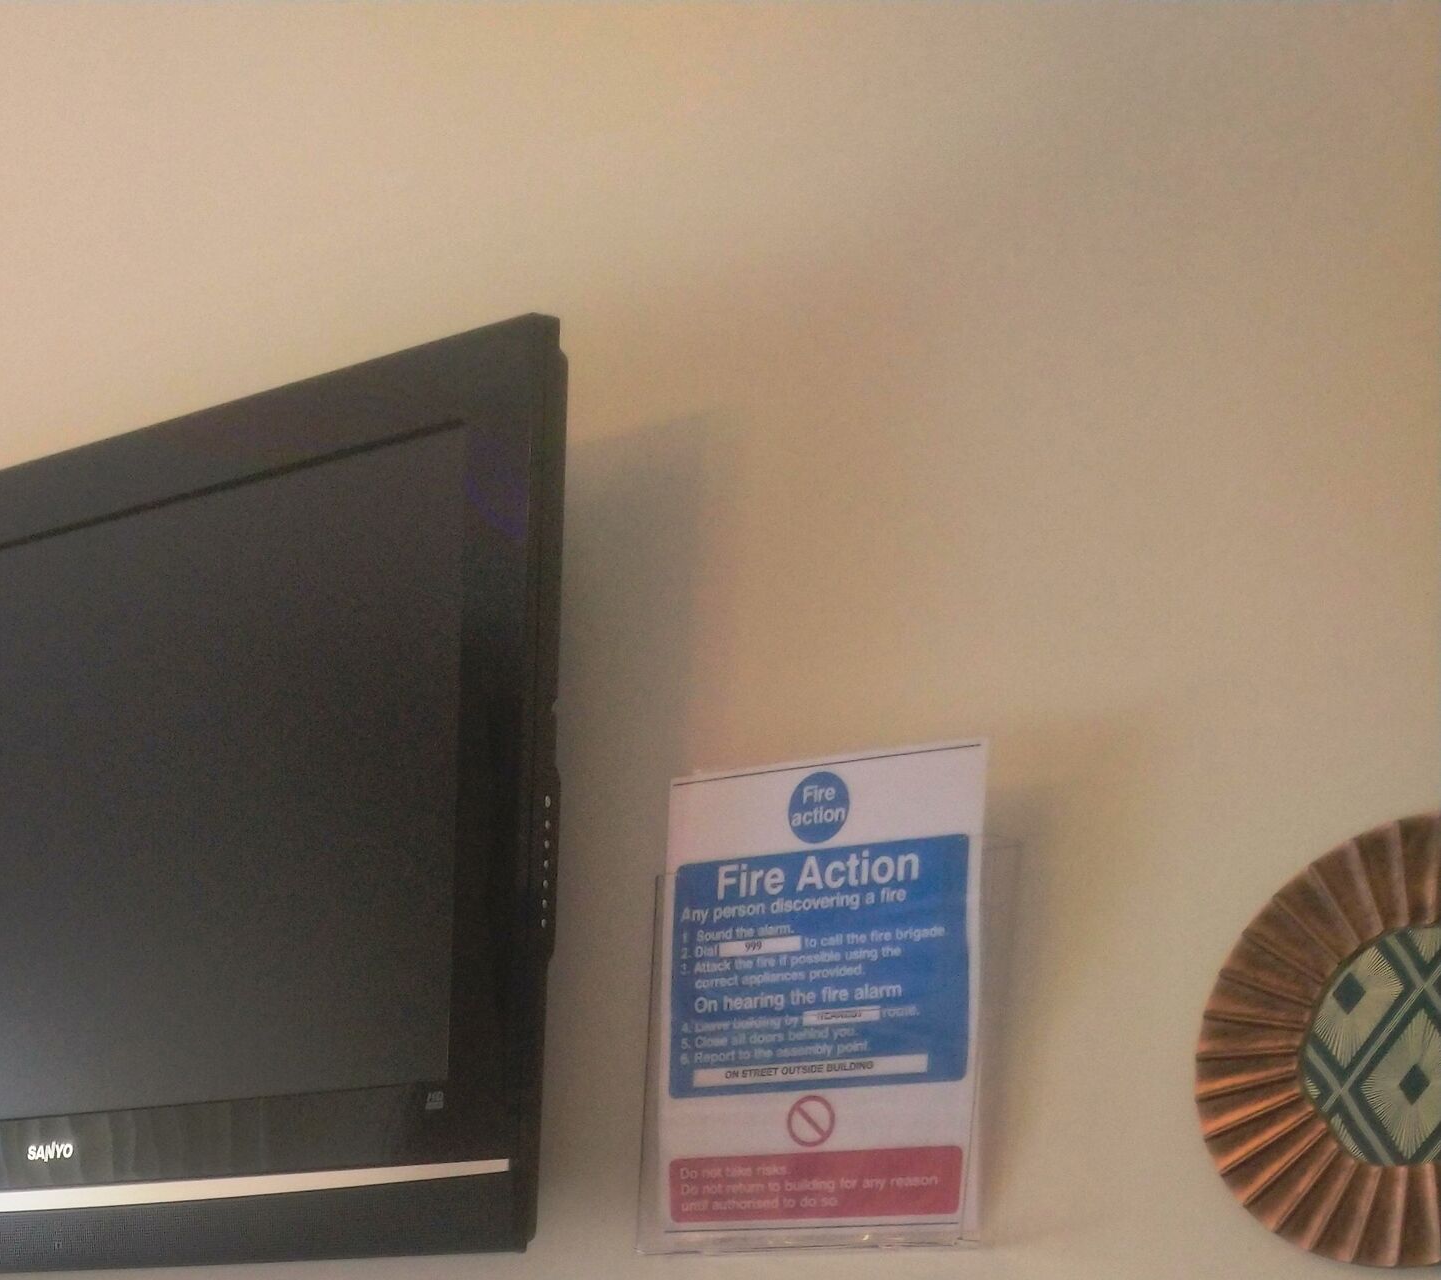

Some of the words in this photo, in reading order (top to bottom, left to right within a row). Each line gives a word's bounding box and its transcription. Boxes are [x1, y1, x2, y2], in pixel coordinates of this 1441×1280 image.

[802, 784, 836, 804] Fire
[791, 805, 846, 827] action
[717, 863, 786, 900] Fire
[796, 850, 920, 892] Action
[681, 906, 709, 925] Any
[713, 901, 766, 922] person
[771, 891, 860, 914] discovering
[865, 893, 876, 905] a
[880, 887, 907, 902] fire
[695, 945, 718, 959] Dial
[744, 940, 763, 951] 999
[804, 937, 817, 948] to
[820, 934, 843, 947] call
[846, 932, 868, 944] the
[870, 929, 892, 942] fire
[895, 925, 946, 942] brigade
[696, 926, 732, 942] Sound
[735, 926, 755, 938] the
[758, 923, 794, 937] alarm.
[694, 960, 731, 974] Attack
[735, 957, 754, 970] the
[757, 955, 777, 967] fire
[779, 954, 788, 966] if
[790, 951, 842, 968] possible
[845, 947, 878, 961] using
[881, 945, 902, 957] the
[695, 975, 739, 989] correct
[741, 970, 807, 987] appliances
[694, 996, 719, 1014] On
[723, 991, 786, 1011] hearing
[790, 988, 816, 1006] the
[821, 986, 849, 1003] fire
[854, 983, 903, 1000] alarm
[694, 1035, 728, 1049] Close
[731, 1033, 747, 1046] all
[749, 1030, 785, 1043] doors
[788, 1027, 830, 1041] behind
[694, 1050, 735, 1065] Report
[738, 1048, 751, 1060] to
[753, 1046, 773, 1059] the
[724, 1070, 739, 1080] ON
[741, 1067, 779, 1079] STREET
[781, 1063, 824, 1076] OUTSIDE
[826, 1060, 874, 1074] BUILDING
[27, 1140, 73, 1163] SANYO
[680, 1166, 697, 1180] Do
[680, 1183, 698, 1196] Do
[702, 1182, 723, 1195] not
[784, 1178, 835, 1192] building
[839, 1177, 858, 1190] for
[862, 1177, 886, 1192] any
[890, 1175, 938, 1187] reason
